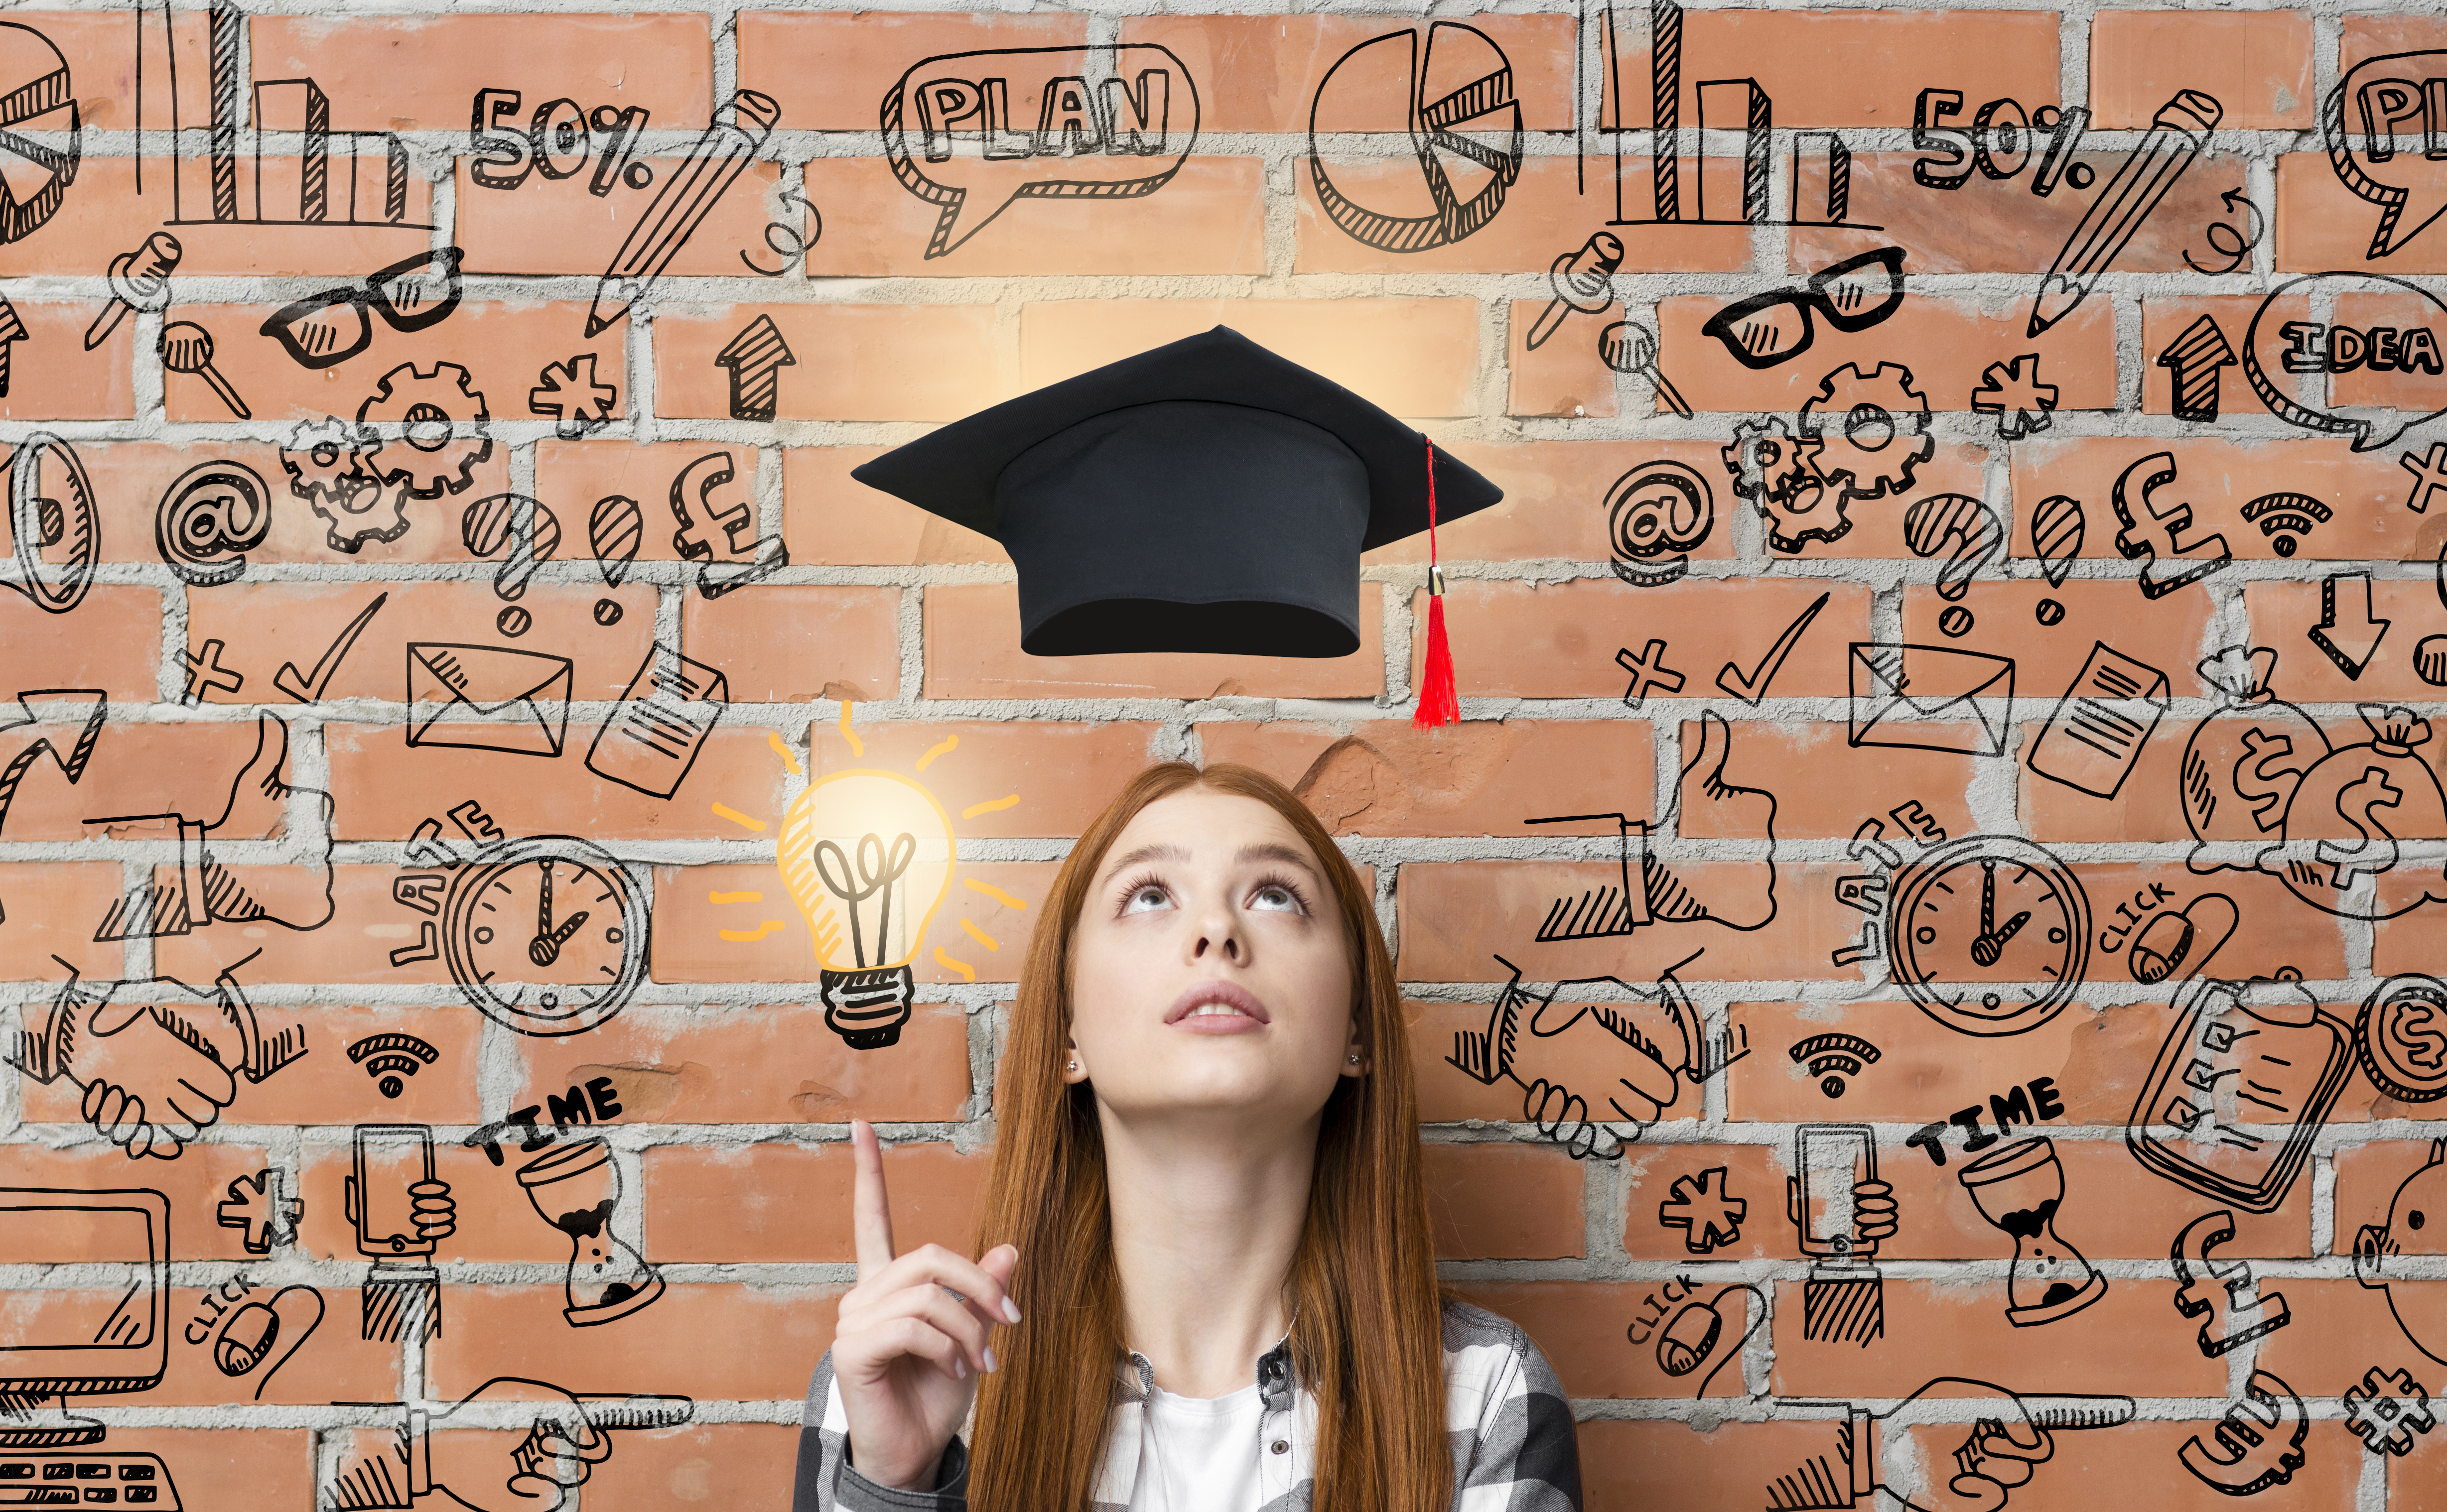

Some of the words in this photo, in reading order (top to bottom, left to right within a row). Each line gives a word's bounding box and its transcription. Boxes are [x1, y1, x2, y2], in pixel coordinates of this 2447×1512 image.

[471, 88, 653, 198] 50%
[914, 69, 1170, 162] PLAN
[1913, 88, 2095, 198] 50%
[2282, 321, 2444, 376] IDEA
[390, 800, 505, 967] LATE
[1832, 800, 1947, 967] LATE
[2099, 882, 2175, 953] CLICK
[463, 1077, 623, 1166] TIME
[1905, 1077, 2065, 1166] TIME
[185, 1273, 261, 1345] CLICK
[1627, 1273, 1703, 1345] CLICK
